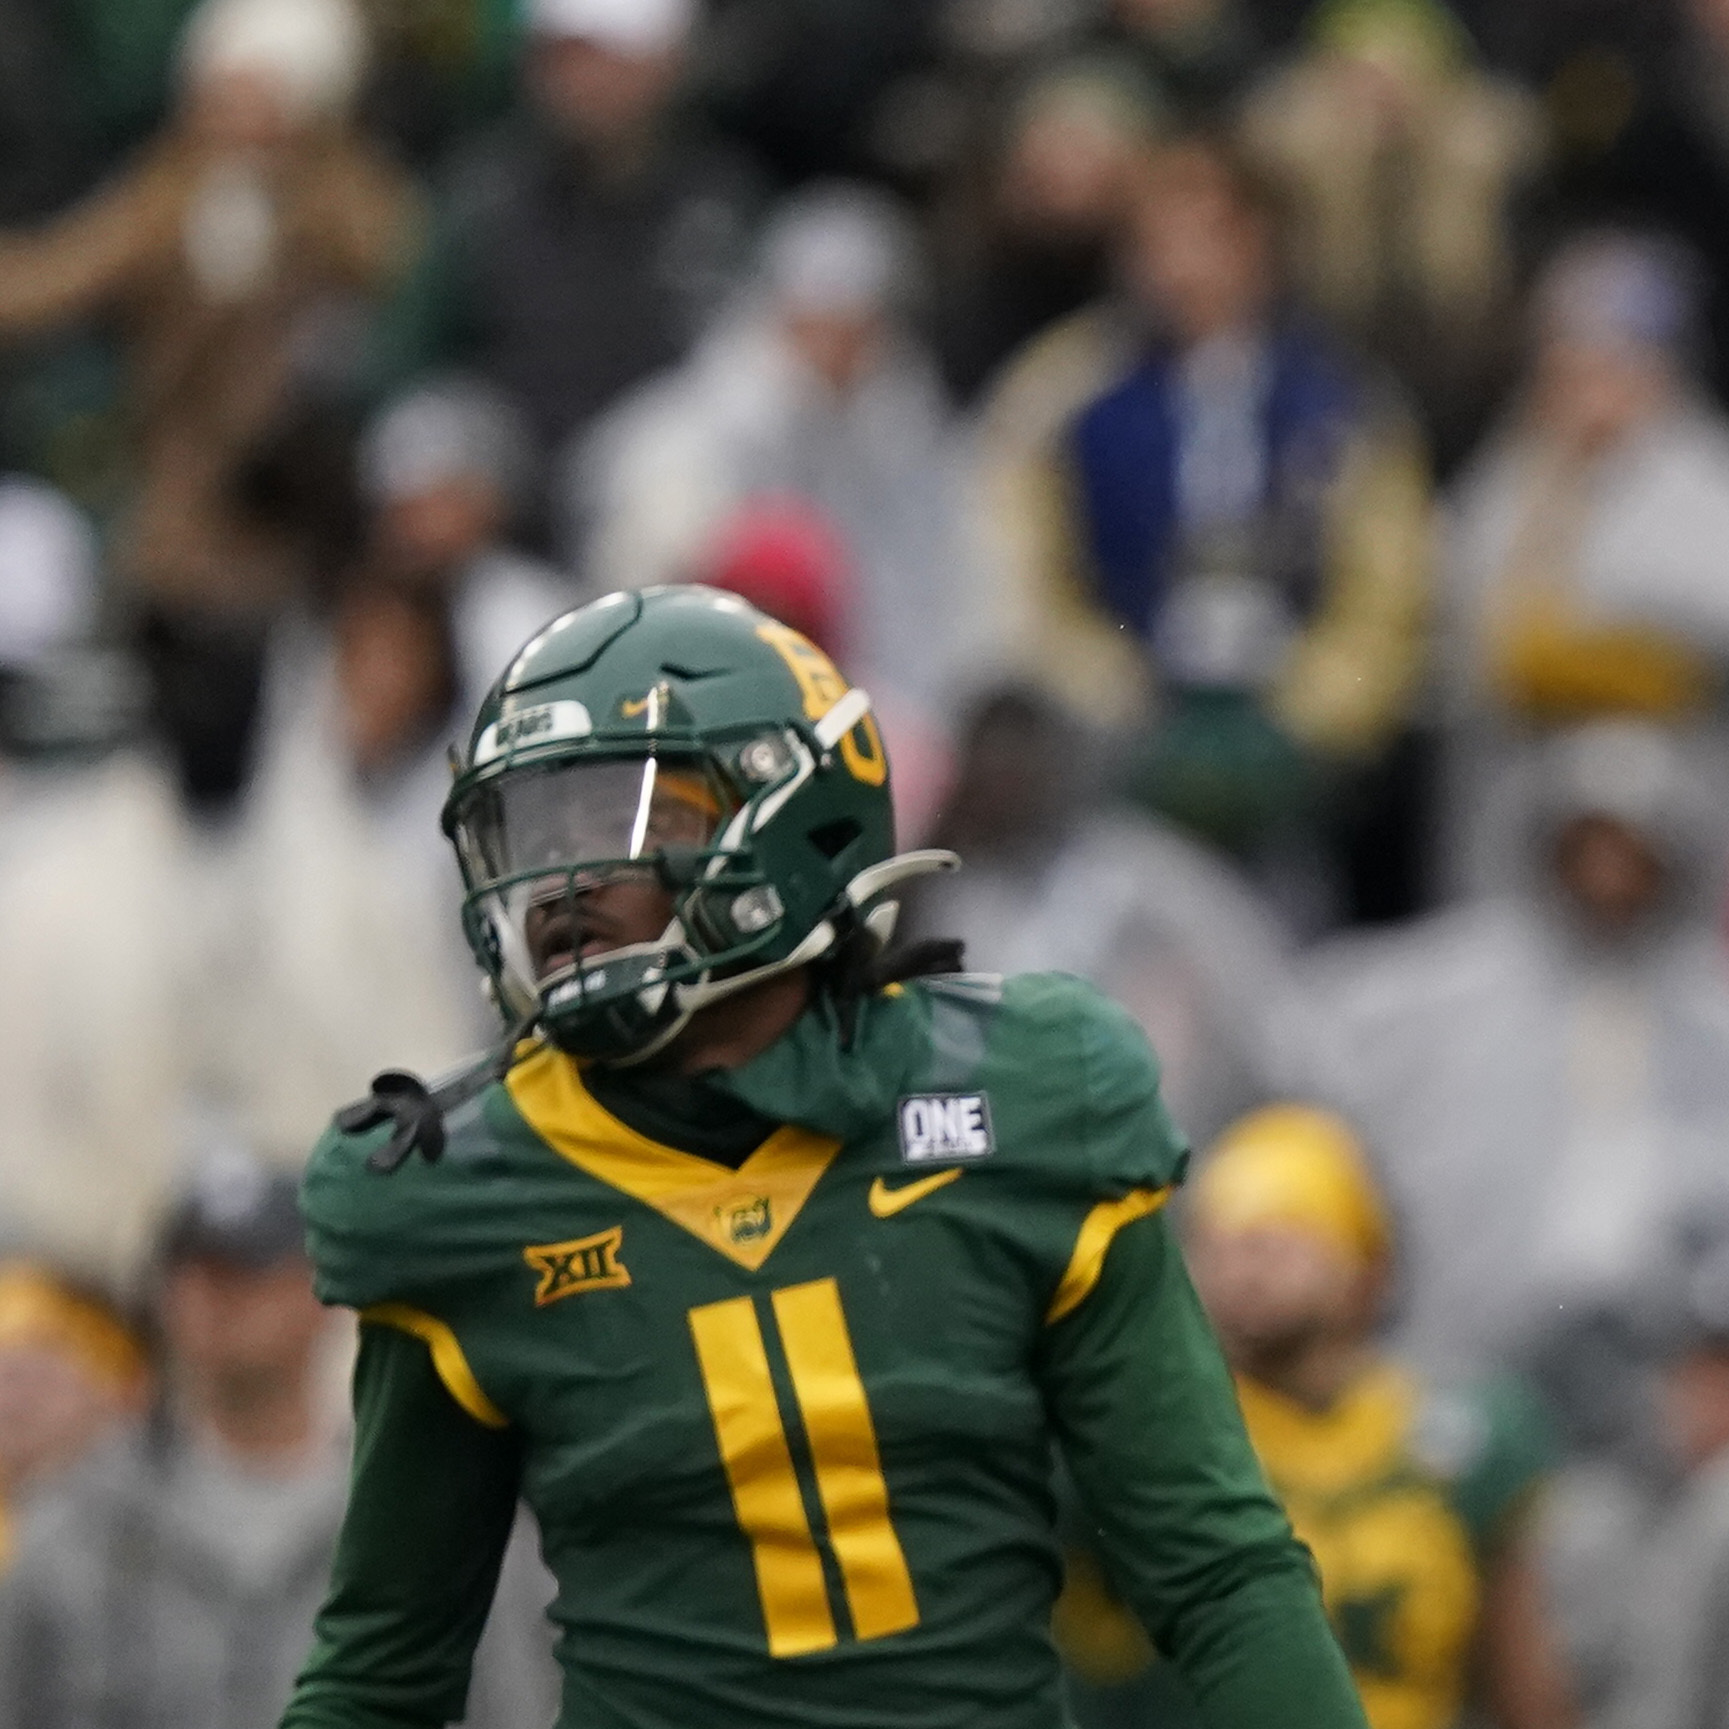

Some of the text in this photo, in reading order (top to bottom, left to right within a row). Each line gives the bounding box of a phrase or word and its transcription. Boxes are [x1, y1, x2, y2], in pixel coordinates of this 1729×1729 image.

[903, 1096, 986, 1145] ONE
[540, 1238, 619, 1295] XII
[687, 1276, 920, 1658] 11
